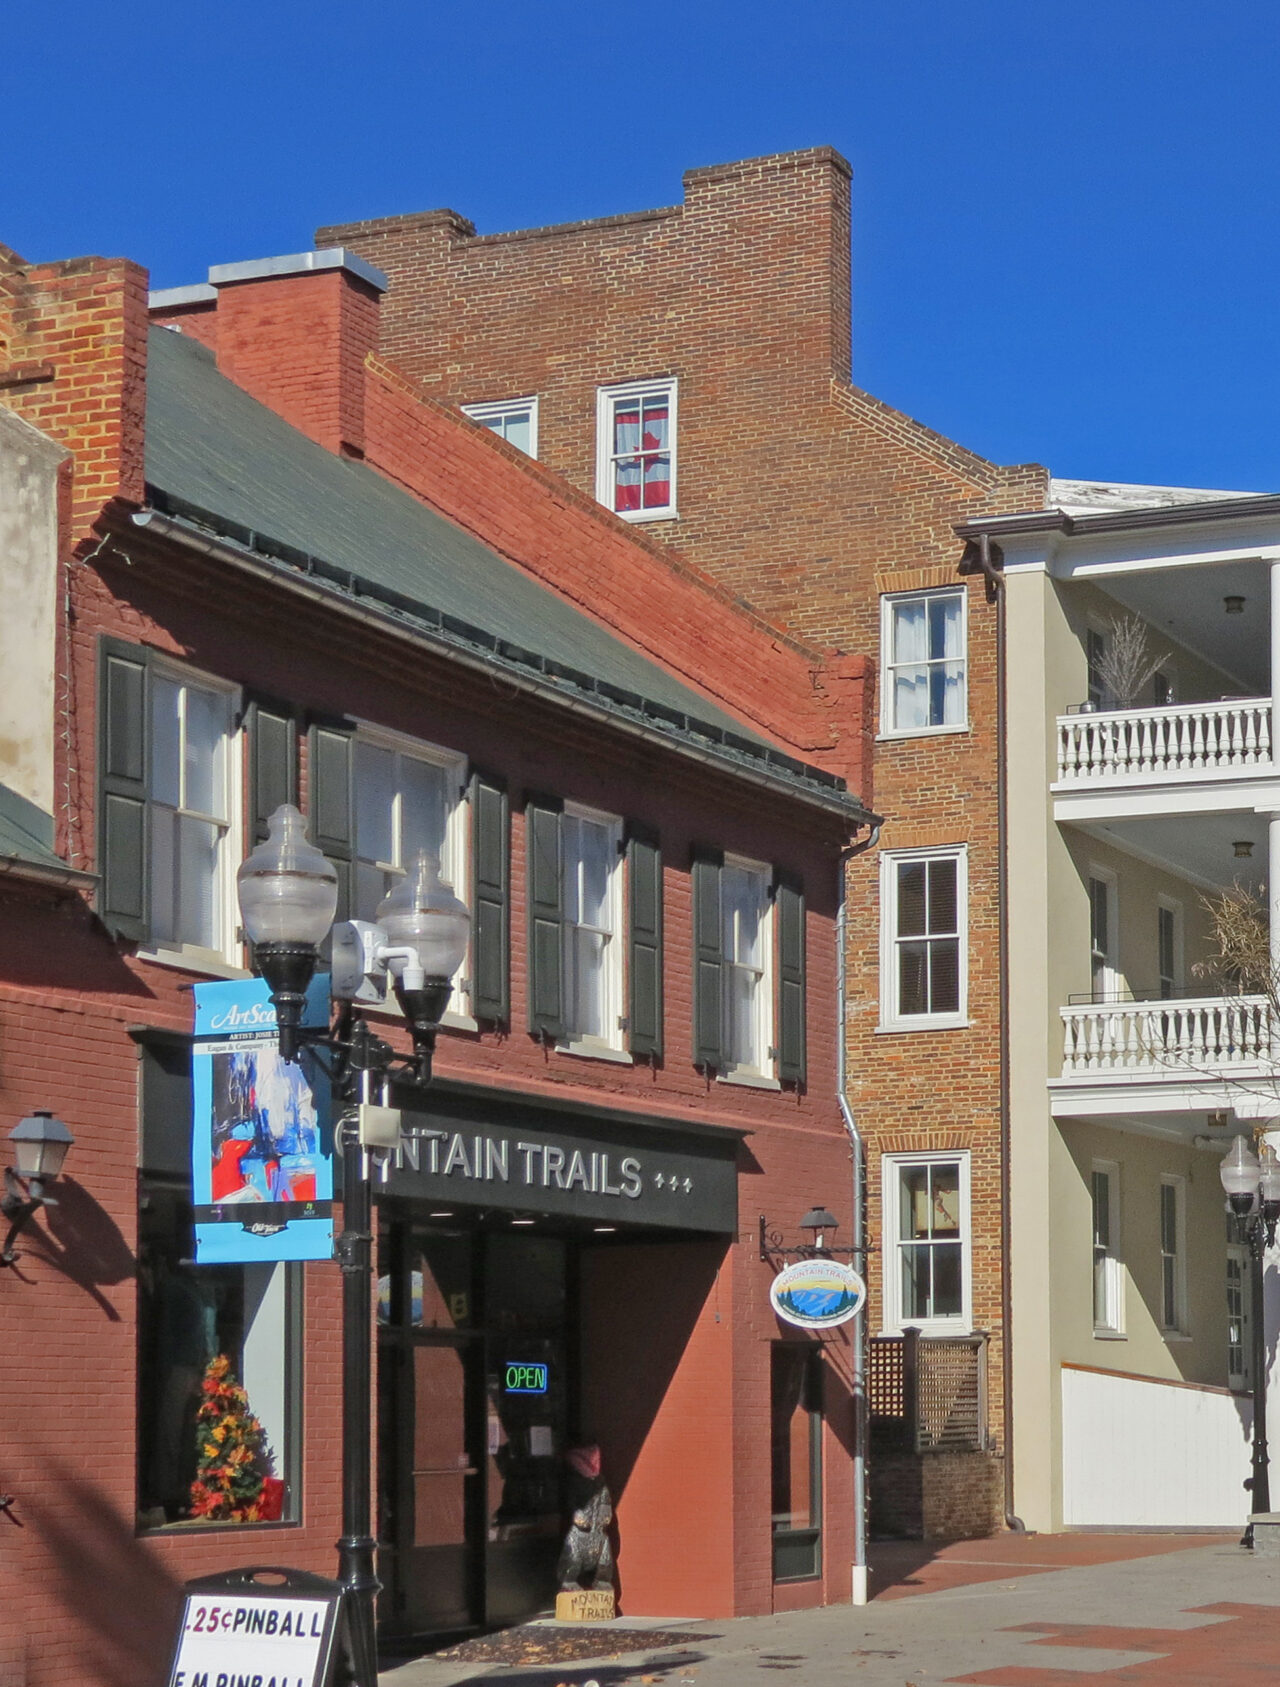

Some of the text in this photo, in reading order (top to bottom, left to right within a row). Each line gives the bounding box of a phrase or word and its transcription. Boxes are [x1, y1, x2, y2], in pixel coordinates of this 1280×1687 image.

[210, 1004, 277, 1028] ArtSca
[517, 1141, 642, 1198] TRAILS
[782, 1269, 853, 1287] MOUNTAIN TRAILS
[506, 1366, 545, 1389] OPEN
